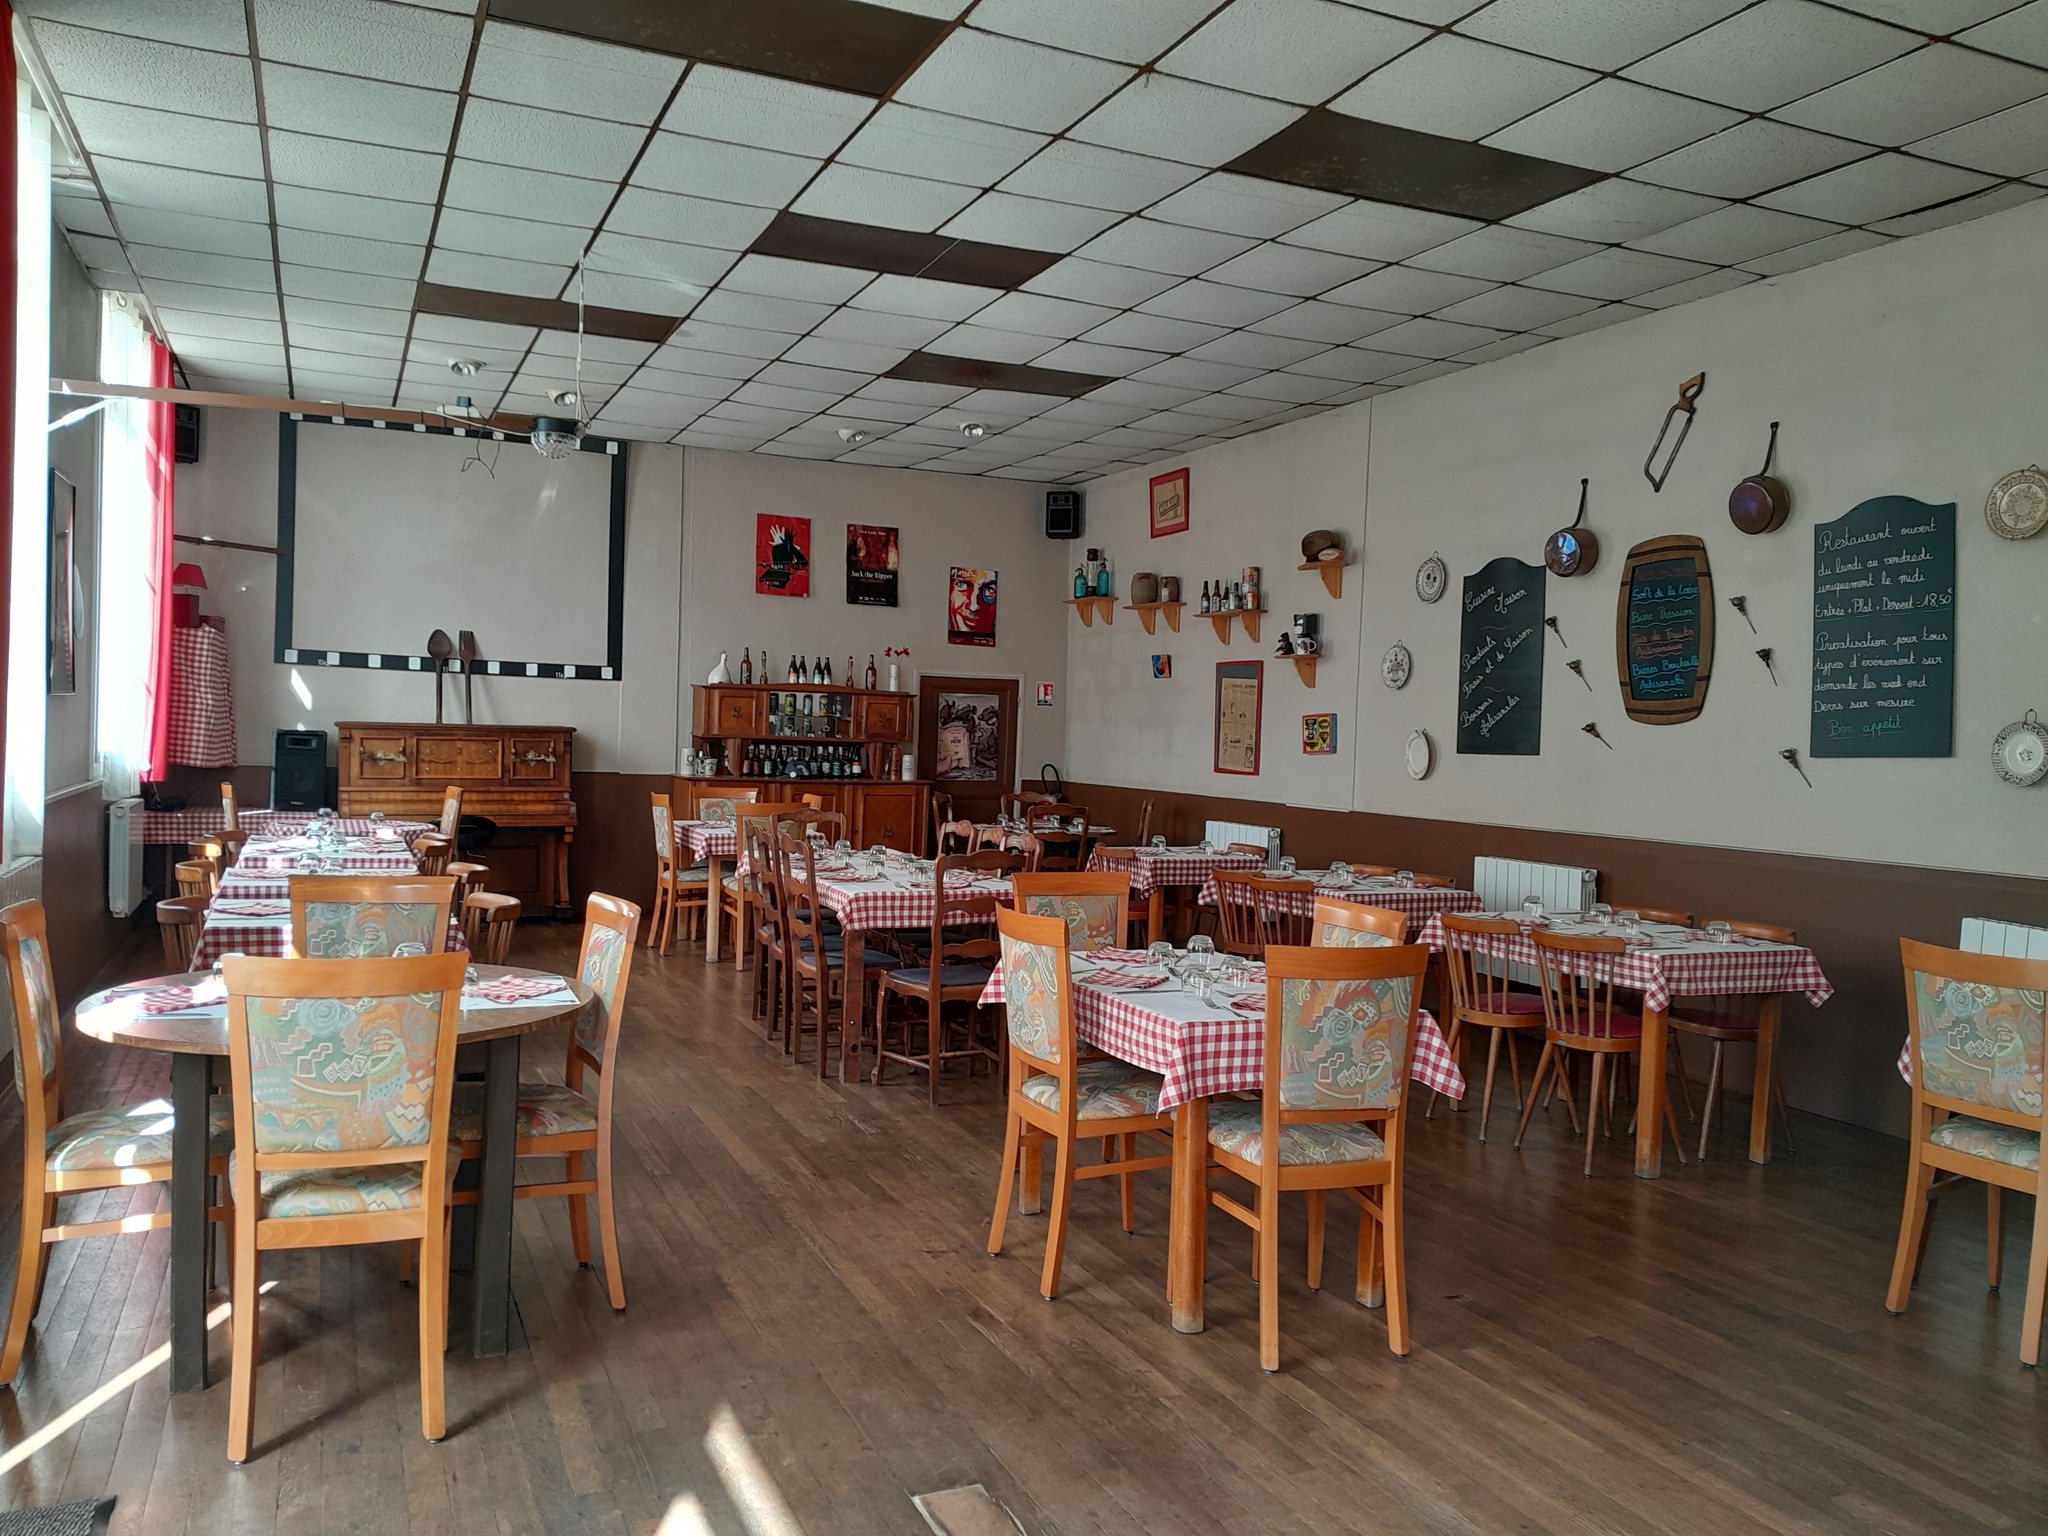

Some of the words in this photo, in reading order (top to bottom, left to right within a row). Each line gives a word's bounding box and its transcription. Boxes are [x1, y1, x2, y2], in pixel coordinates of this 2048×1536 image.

[1818, 522, 1893, 553] Restaurant
[1901, 517, 1937, 536] ouvert
[1818, 565, 1832, 577] du
[1836, 556, 1863, 573] lundi
[1867, 558, 1879, 567] au
[1884, 547, 1933, 565] vendredi
[1816, 573, 1874, 598] uniquement
[1881, 571, 1892, 584] le
[1899, 568, 1926, 583] midi
[1815, 604, 1846, 617] Entrée
[1852, 598, 1873, 613] Plat
[1882, 595, 1914, 610] Dessert
[1922, 626, 1948, 641] tous
[1814, 657, 1844, 675] types
[1921, 655, 1943, 664] sur
[1814, 675, 1858, 692] demande
[1862, 673, 1877, 689] les
[1814, 700, 1844, 713] Devis
[1849, 701, 1870, 709] sur
[1876, 698, 1916, 707] mesure
[1827, 719, 1856, 737] Bon
